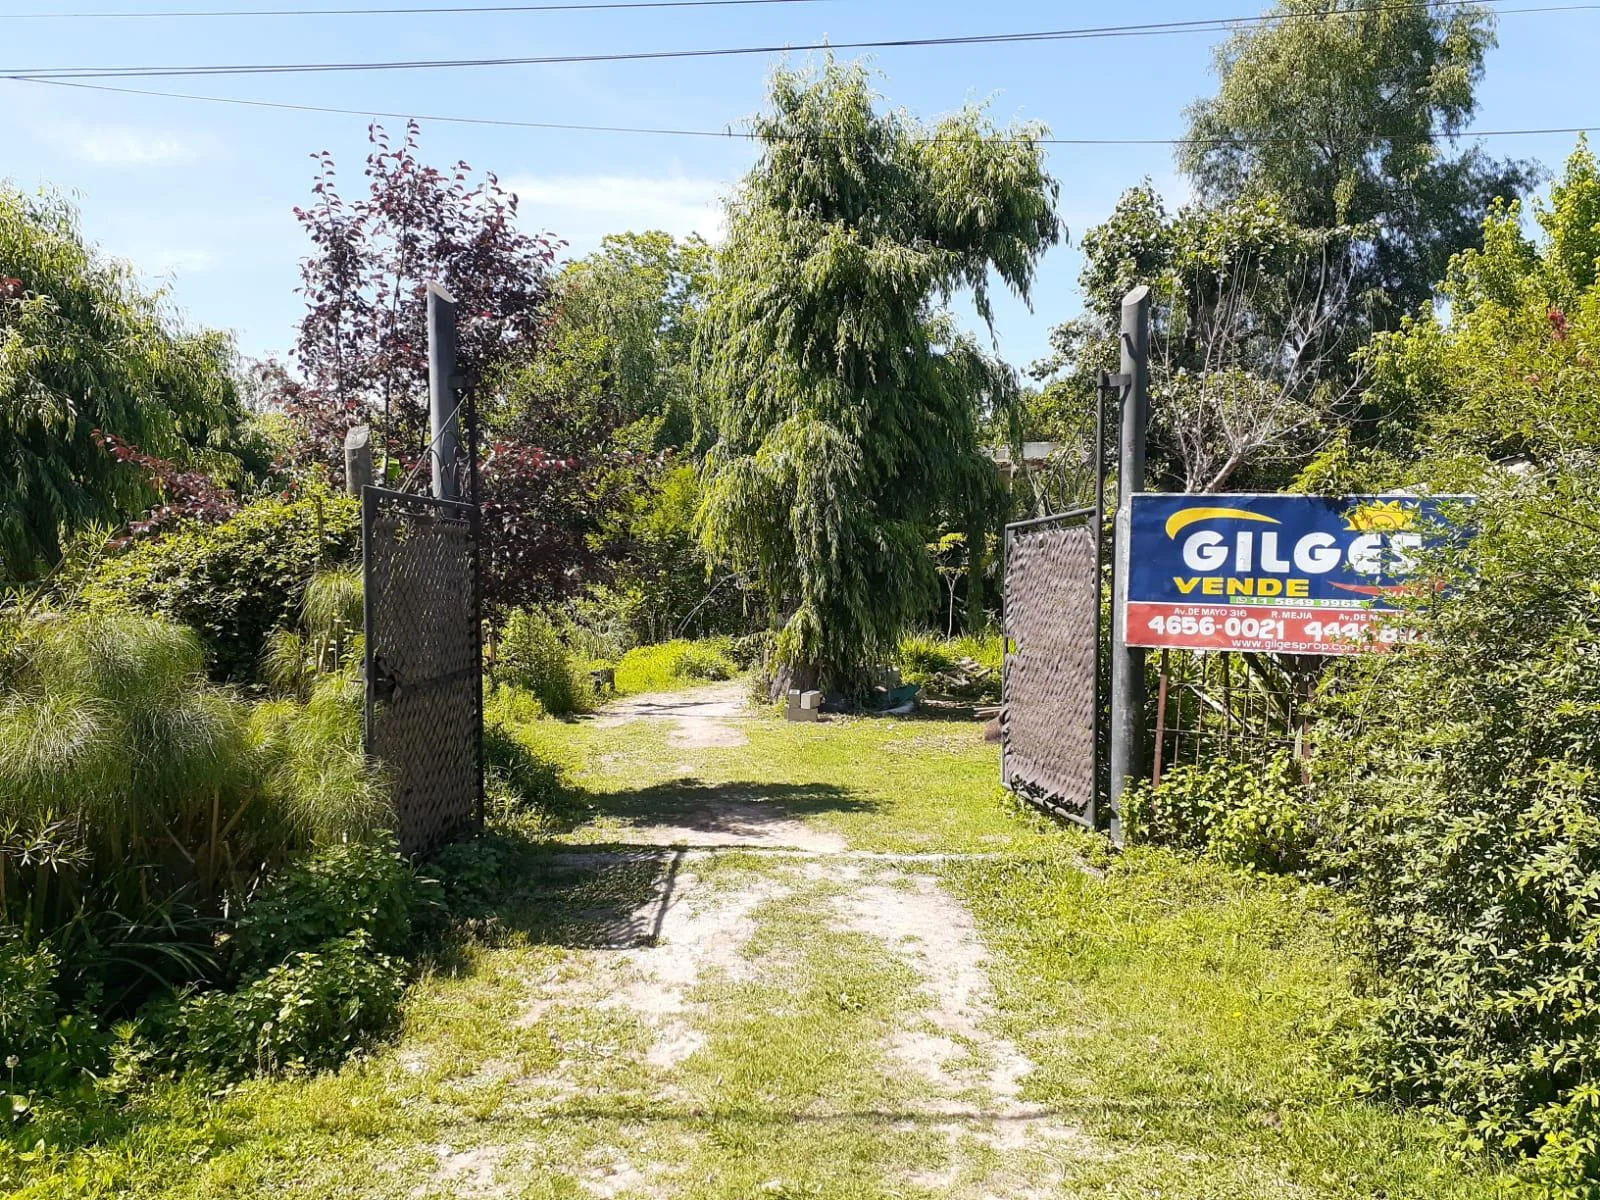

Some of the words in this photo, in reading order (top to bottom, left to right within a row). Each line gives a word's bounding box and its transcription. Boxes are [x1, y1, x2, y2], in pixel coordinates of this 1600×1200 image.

[1182, 530, 1422, 575] GILGES
[1173, 576, 1310, 598] VENDE
[1251, 597, 1268, 605] 11
[1201, 608, 1228, 617] MAYO
[1229, 609, 1248, 618] 316
[1147, 615, 1285, 640] 4656-0021
